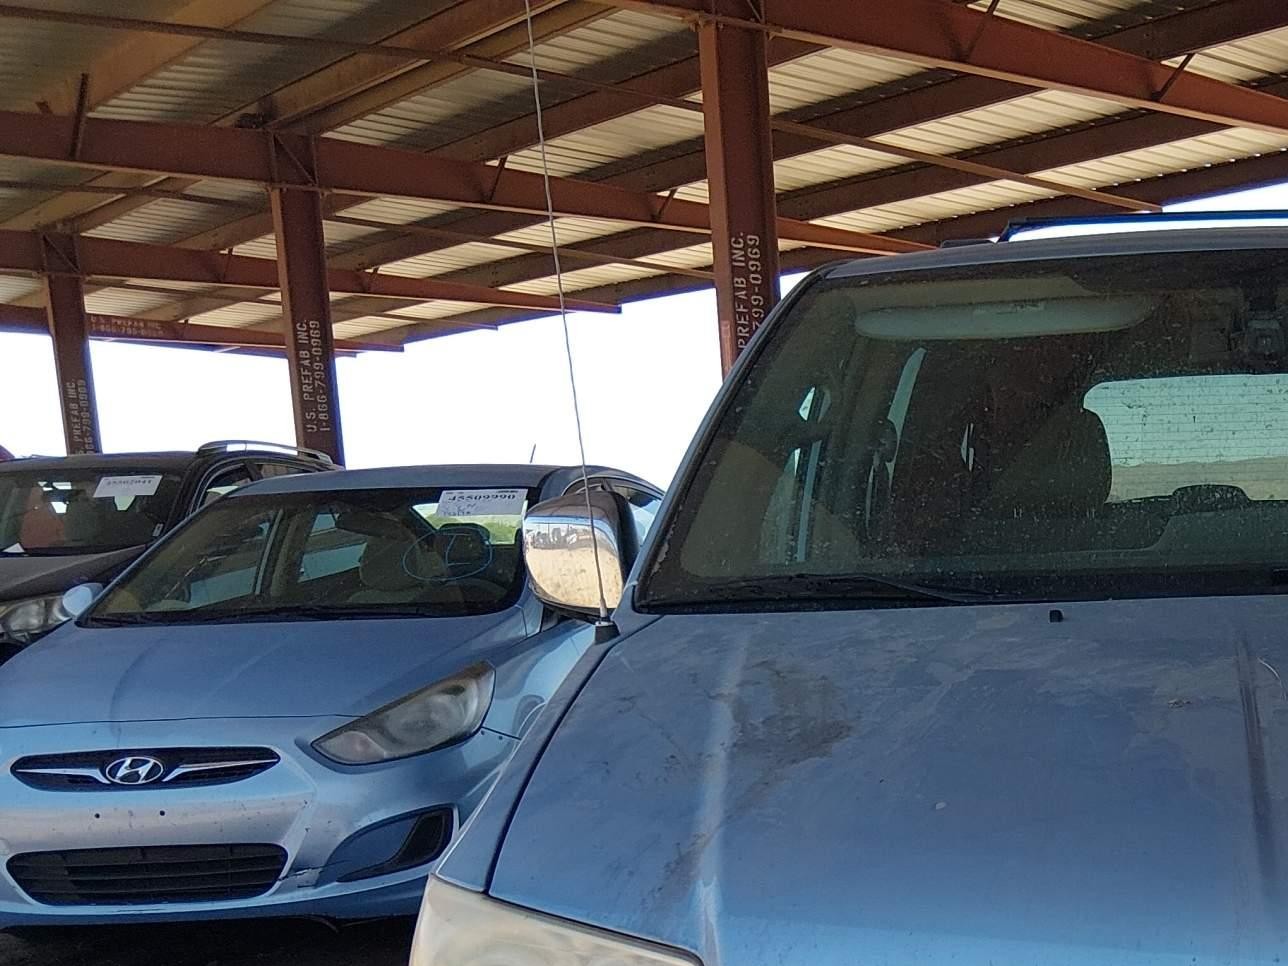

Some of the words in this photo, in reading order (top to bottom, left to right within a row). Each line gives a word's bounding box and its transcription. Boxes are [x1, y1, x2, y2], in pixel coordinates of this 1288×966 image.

[731, 232, 745, 267] INC.
[296, 319, 309, 344] INC.
[733, 277, 750, 349] PREFAB
[300, 350, 315, 401] PREFAB
[309, 320, 331, 432] 1-866-799-0969
[305, 407, 318, 432] U.S.
